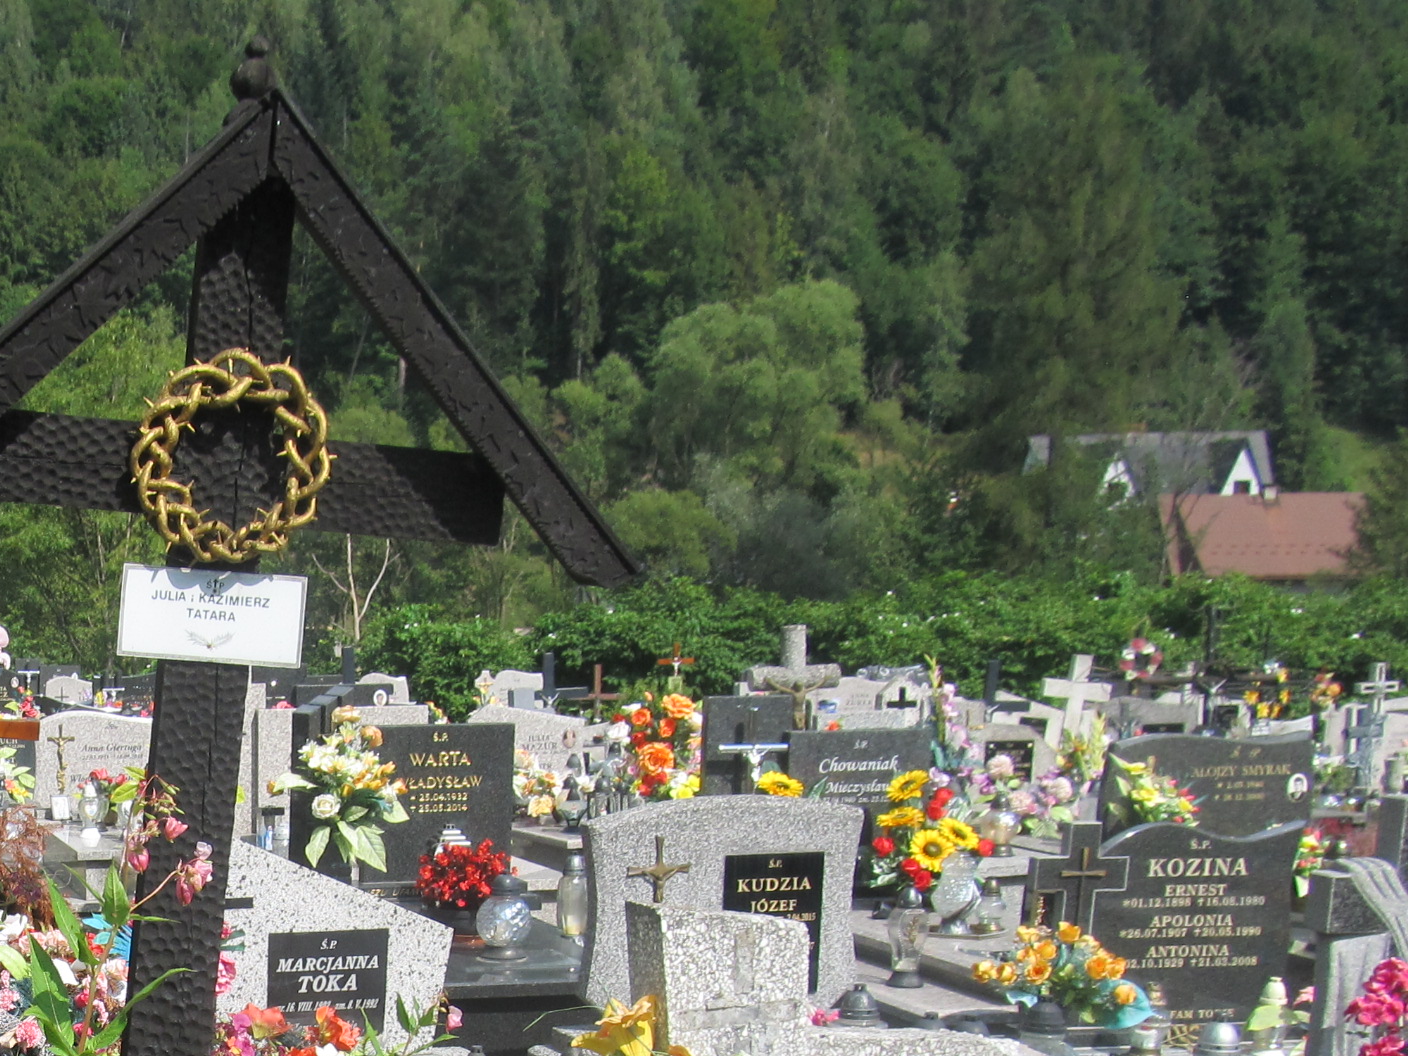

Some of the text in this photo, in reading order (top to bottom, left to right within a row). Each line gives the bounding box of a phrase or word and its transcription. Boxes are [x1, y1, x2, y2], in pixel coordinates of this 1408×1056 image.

[151, 590, 186, 601] JULIA
[198, 594, 270, 608] KAZIMIERZ
[187, 608, 236, 622] TATARA
[409, 751, 472, 767] WARTA
[819, 755, 899, 773] Chowaniak
[1147, 857, 1249, 877] KOZINA
[737, 877, 812, 893] KUDZIA
[1164, 884, 1227, 897] ERNEST
[751, 898, 798, 913] JÓZEF
[1150, 914, 1233, 928] APOLONIA
[320, 938, 338, 950] Ś.P.
[1146, 944, 1230, 958] ANTONINA
[276, 955, 379, 974] MARCJANNA
[298, 973, 358, 993] TOKA
